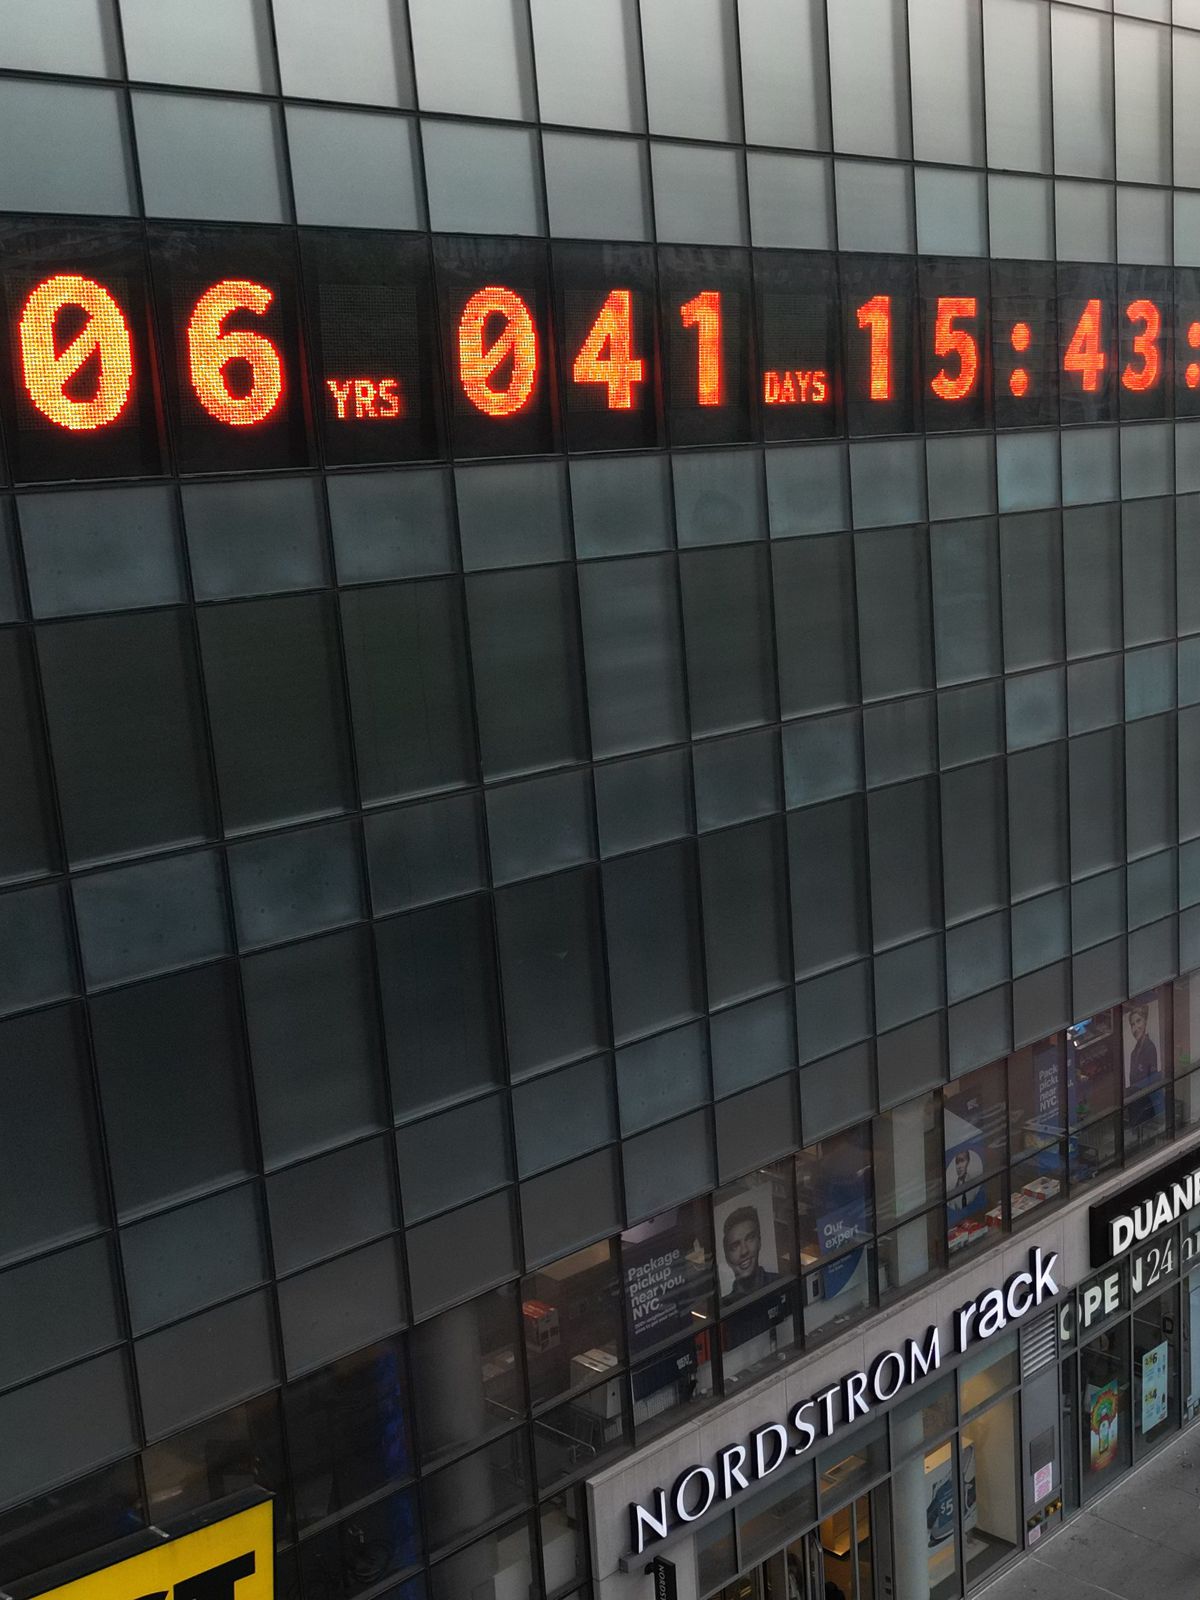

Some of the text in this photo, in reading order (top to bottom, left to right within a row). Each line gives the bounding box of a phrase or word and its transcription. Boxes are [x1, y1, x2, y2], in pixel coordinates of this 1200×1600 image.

[18, 273, 286, 431] 06
[325, 377, 401, 419] YRS
[456, 285, 724, 417] 041
[763, 369, 830, 405] DAYS
[824, 1220, 844, 1237] Our
[627, 1248, 681, 1282] Package
[1145, 1237, 1175, 1288] 24
[628, 1266, 672, 1298] pickup
[631, 1274, 686, 1308] near you,
[632, 1296, 665, 1321] NYC.
[631, 1246, 1061, 1555] NORDSTROM rack
